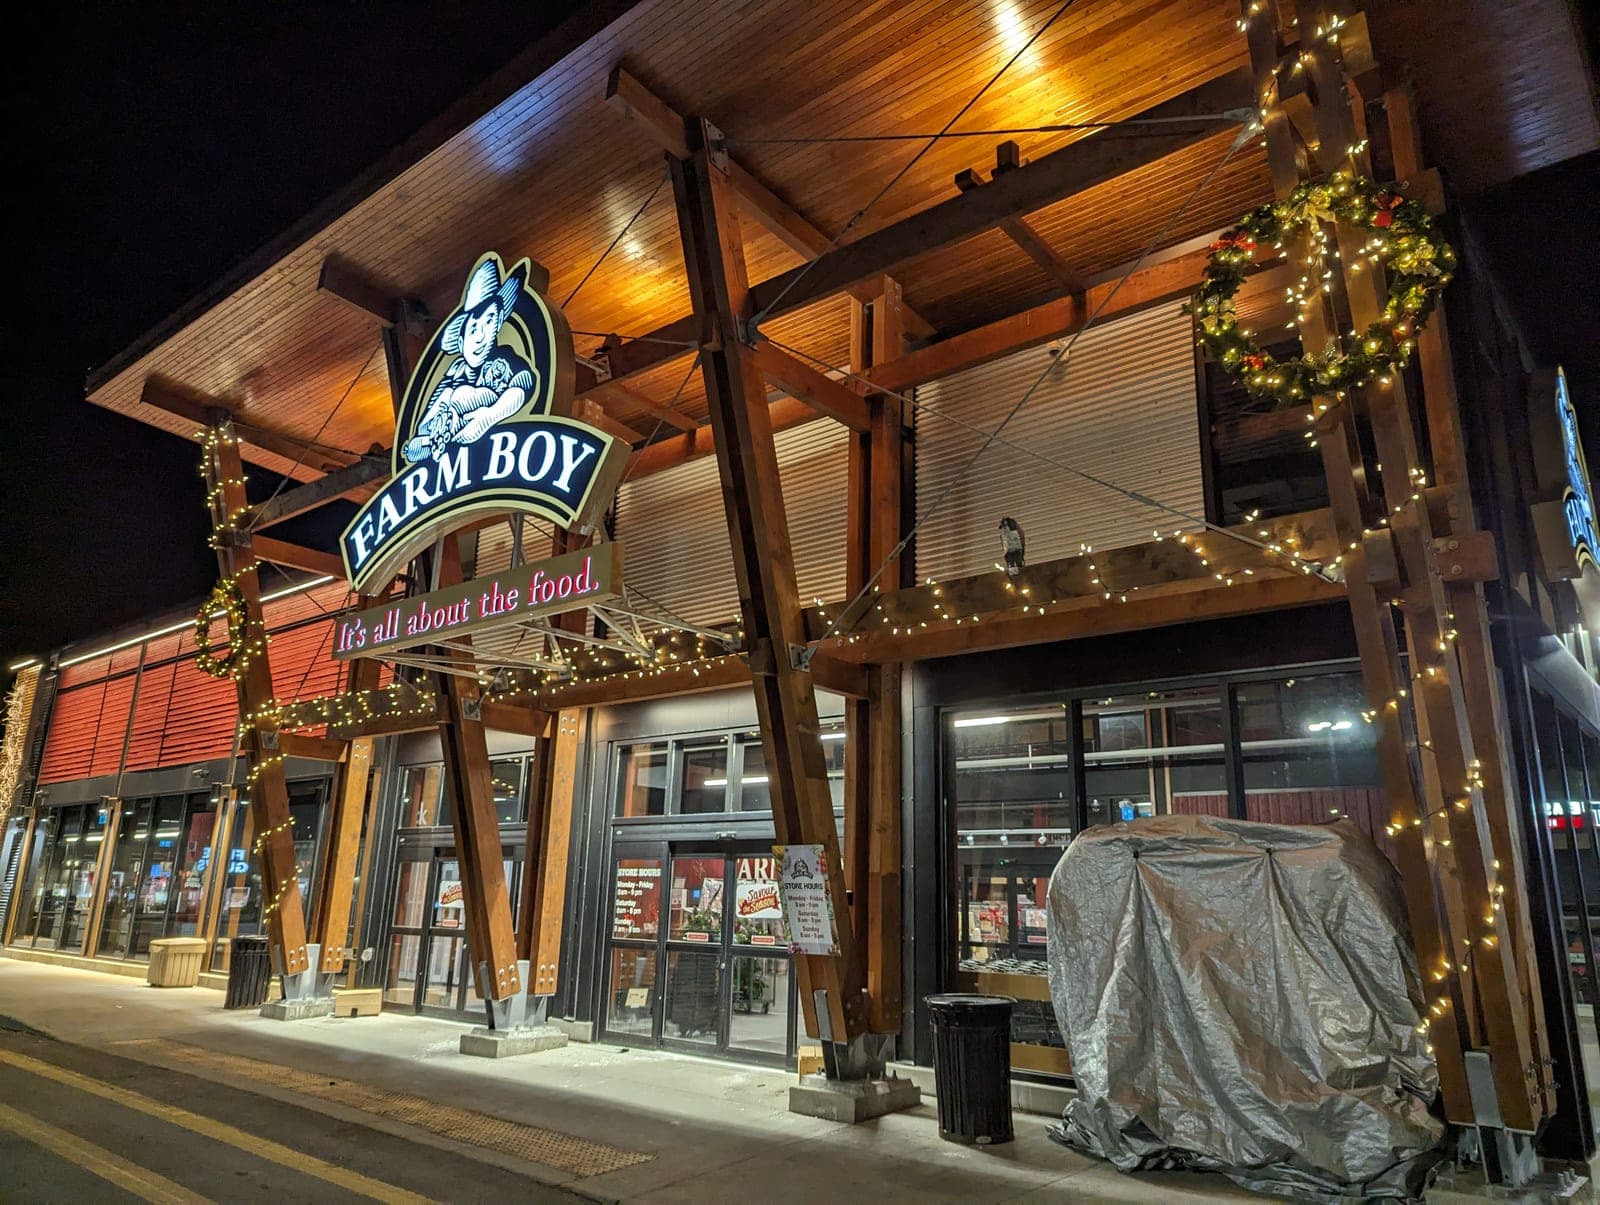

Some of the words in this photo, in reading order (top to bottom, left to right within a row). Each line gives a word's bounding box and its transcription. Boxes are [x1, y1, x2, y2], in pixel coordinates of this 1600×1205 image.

[350, 447, 471, 569] FARM
[482, 430, 596, 493] BOY
[337, 617, 366, 653] It's
[374, 608, 400, 645] all
[407, 598, 470, 637] about
[479, 582, 519, 617] the
[527, 556, 600, 606] food.
[748, 887, 775, 901] Savour
